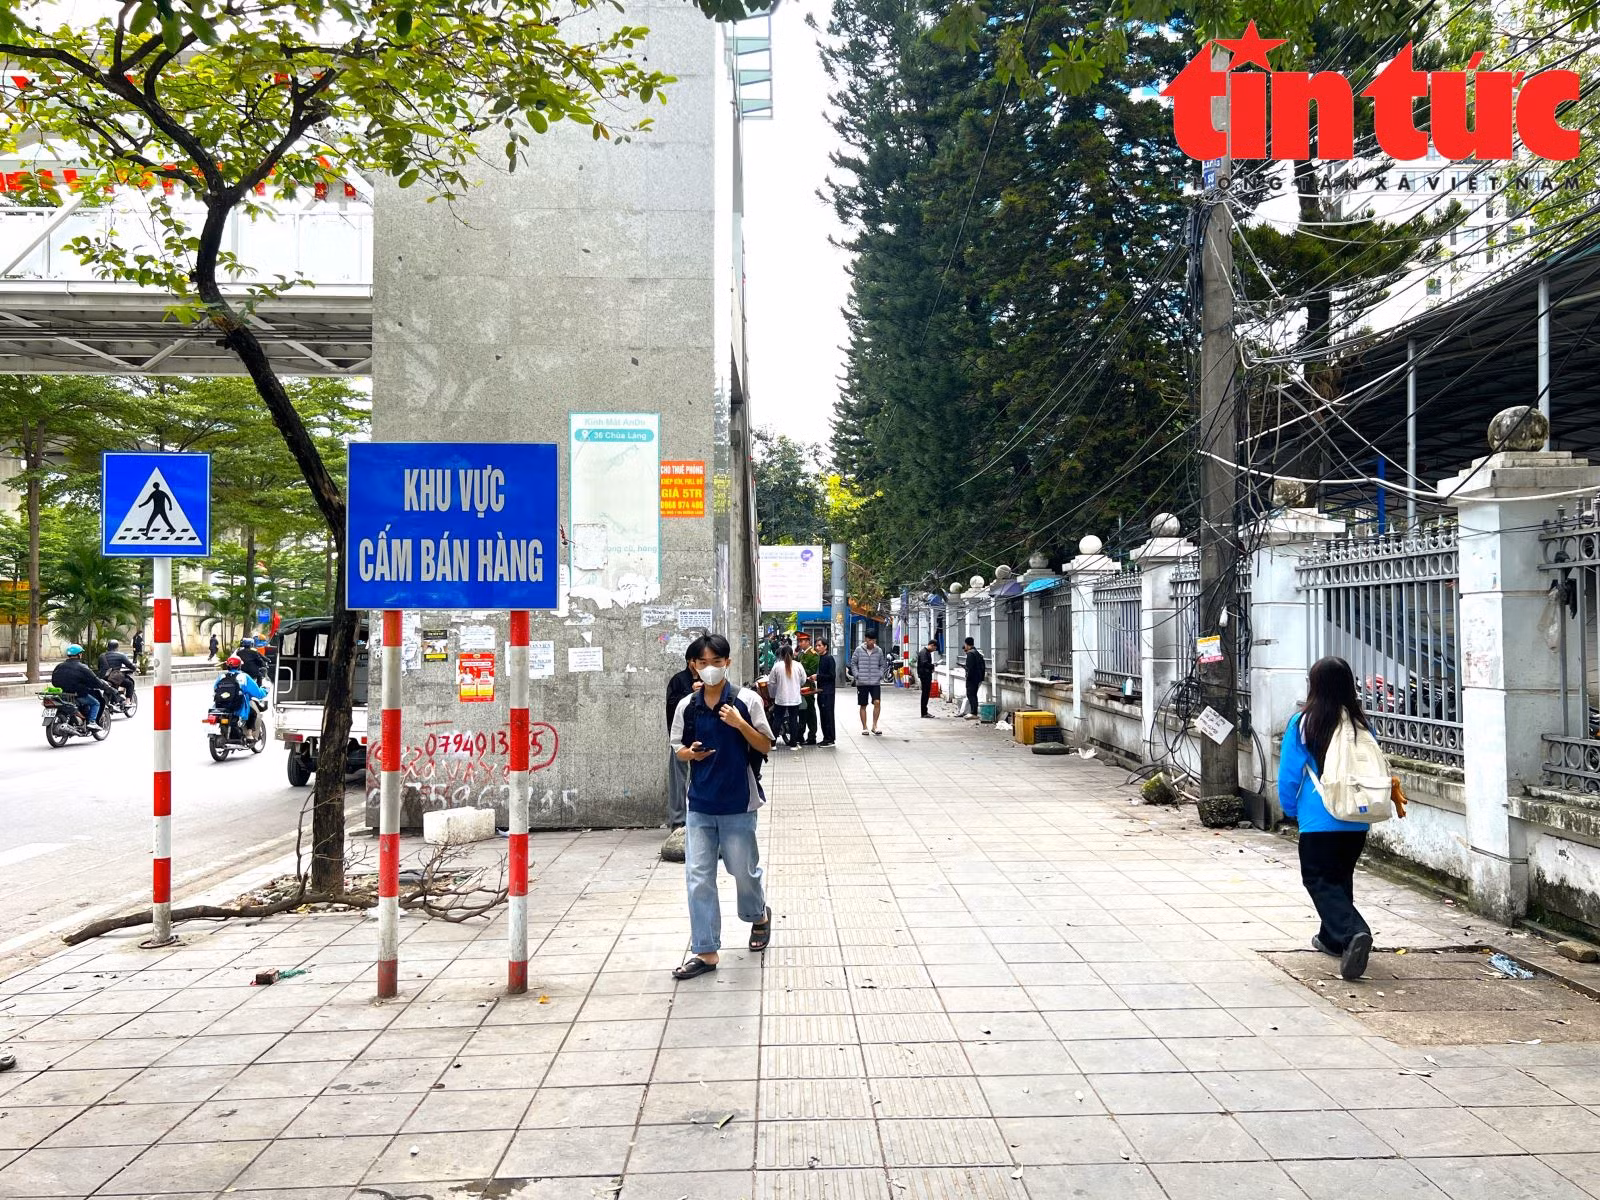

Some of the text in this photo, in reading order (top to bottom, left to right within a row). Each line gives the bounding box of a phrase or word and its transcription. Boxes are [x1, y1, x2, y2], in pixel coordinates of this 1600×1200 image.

[593, 431, 603, 439] 36
[660, 465, 671, 475] CHO
[672, 464, 685, 475] THUÊ
[404, 465, 505, 518] KHU VỰC
[661, 487, 702, 498] GIÁ 5TR
[359, 524, 543, 582] CẤM BÁN HÀNG
